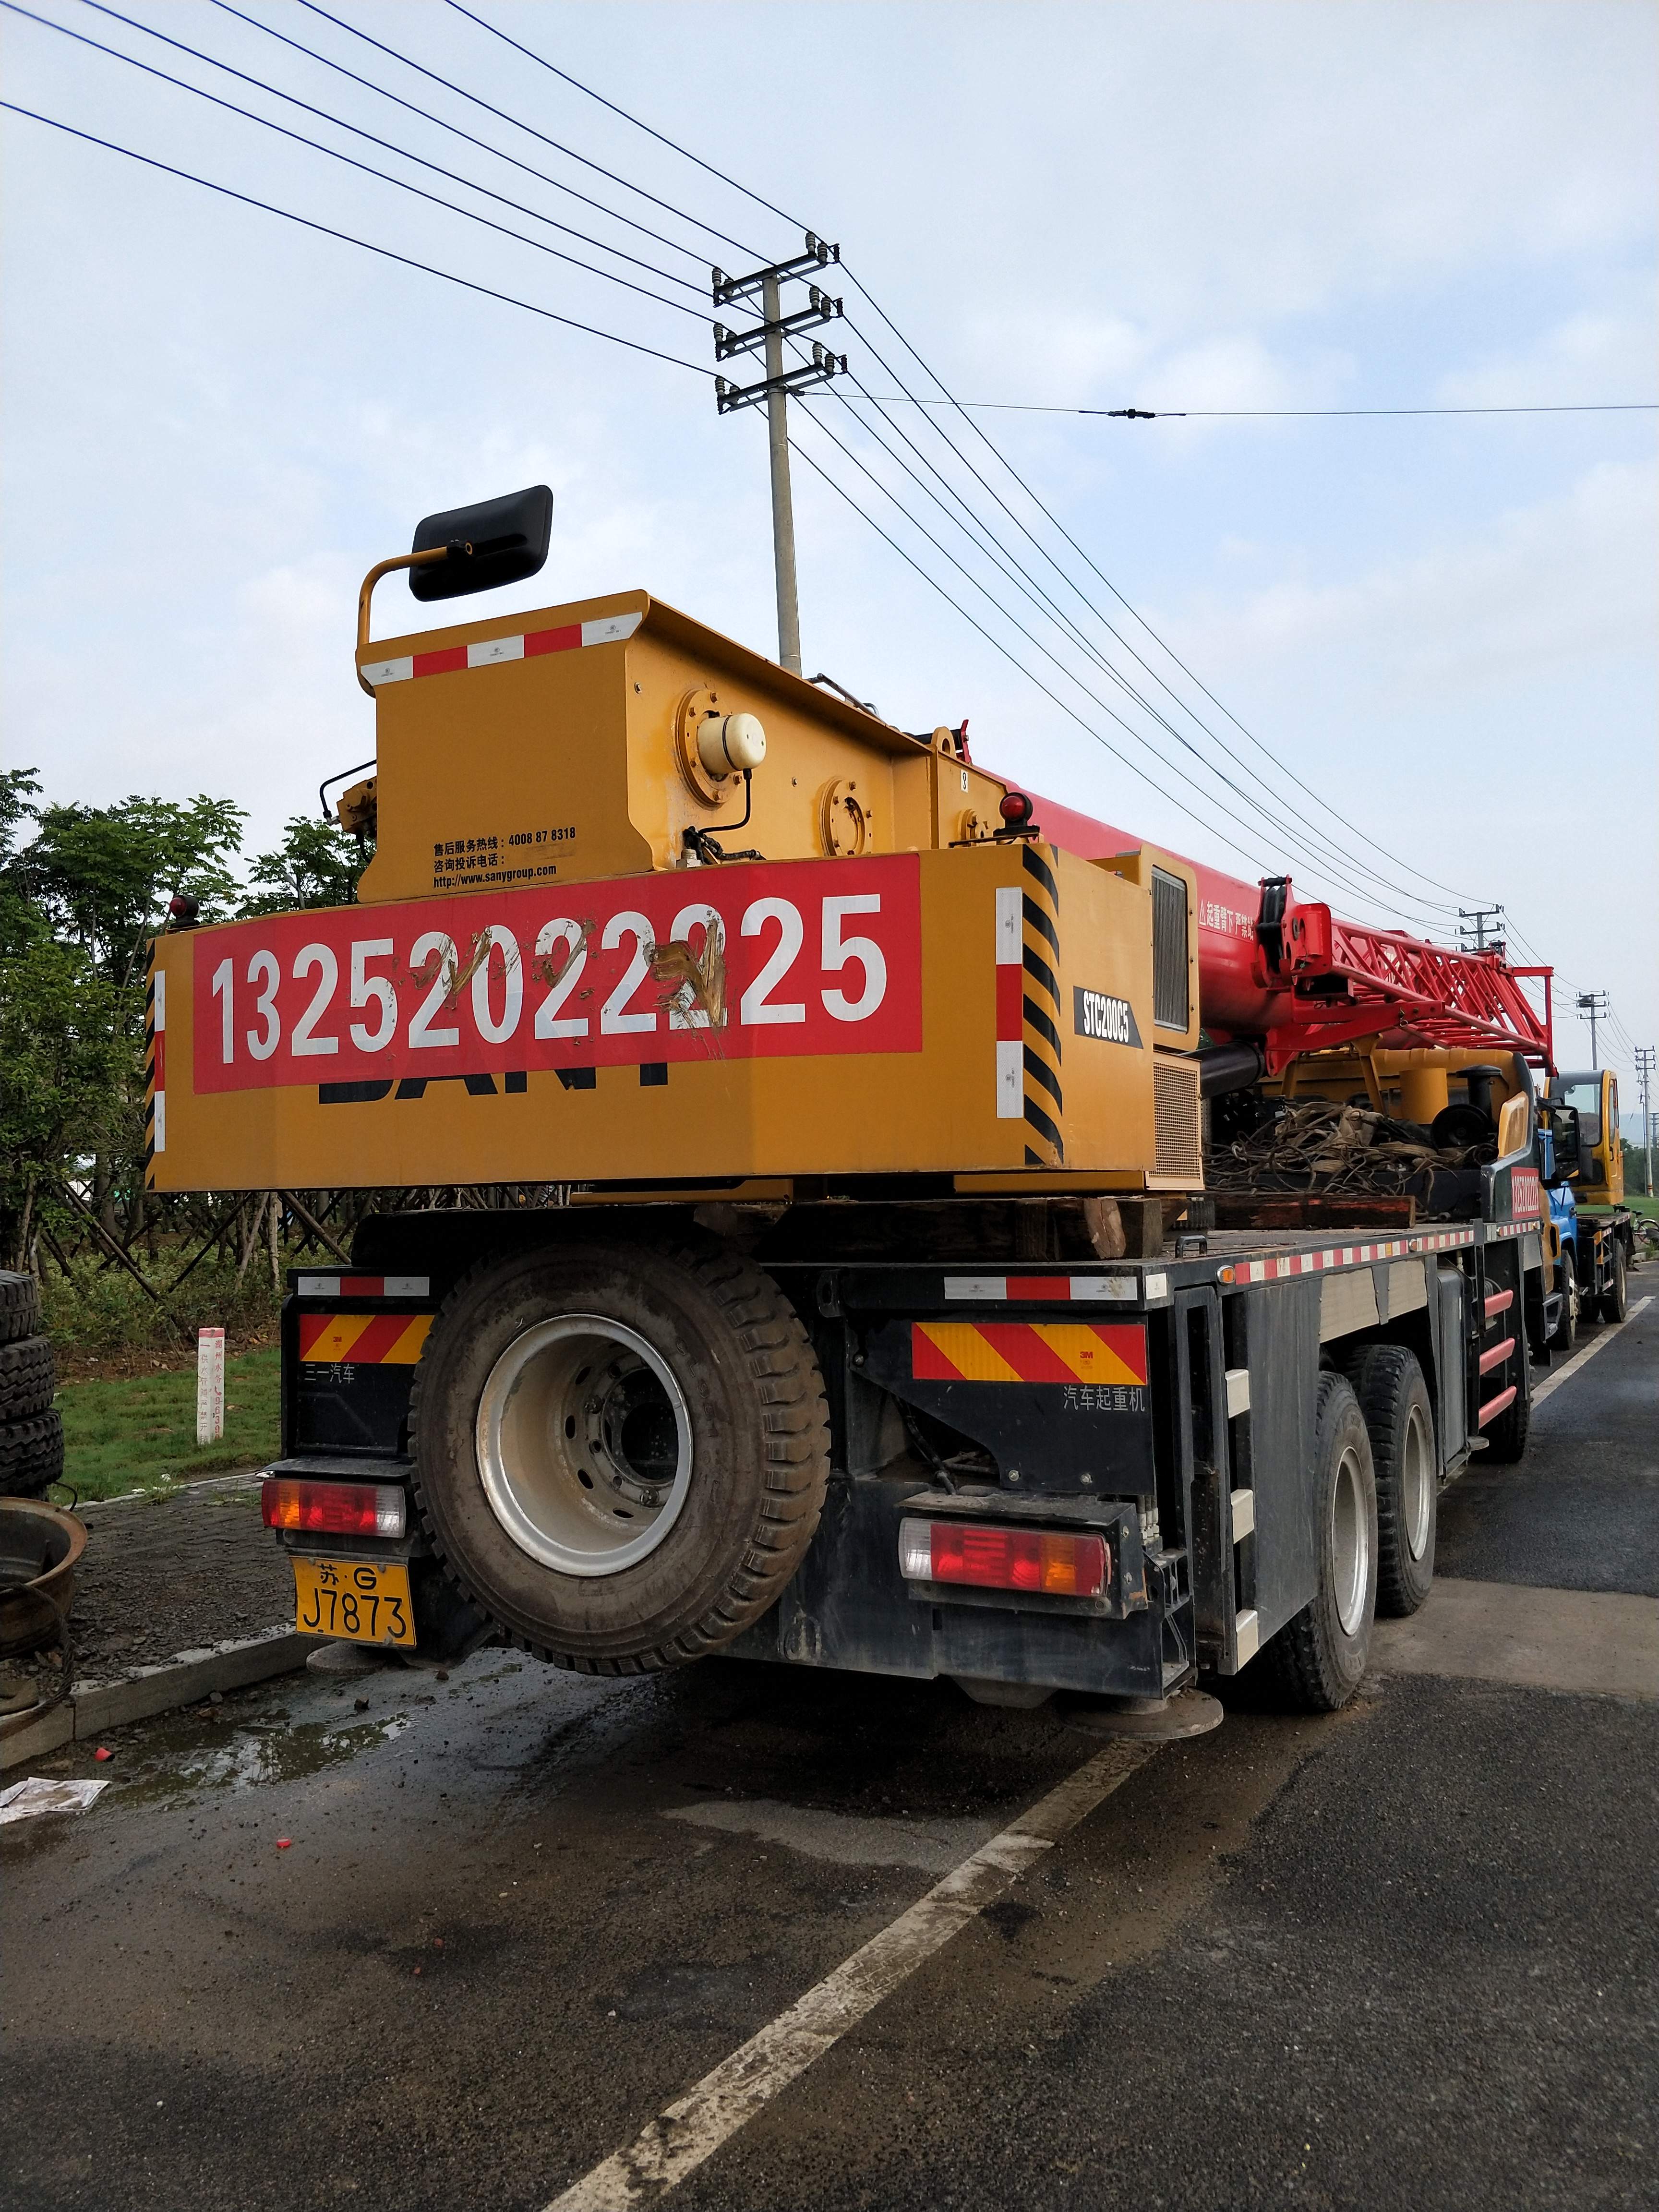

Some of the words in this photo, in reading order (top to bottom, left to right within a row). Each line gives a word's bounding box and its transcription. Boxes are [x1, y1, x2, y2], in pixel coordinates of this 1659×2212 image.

[508, 834, 532, 846] 4008
[536, 830, 548, 843] 87
[551, 827, 576, 841] 8318
[433, 865, 557, 889] http://www.sanygroup.com
[1083, 990, 1129, 1043] STC200C5
[304, 1363, 355, 1383] 三一汽车
[1063, 1384, 1145, 1412] 汽车起重机
[303, 1587, 407, 1638] J7873
